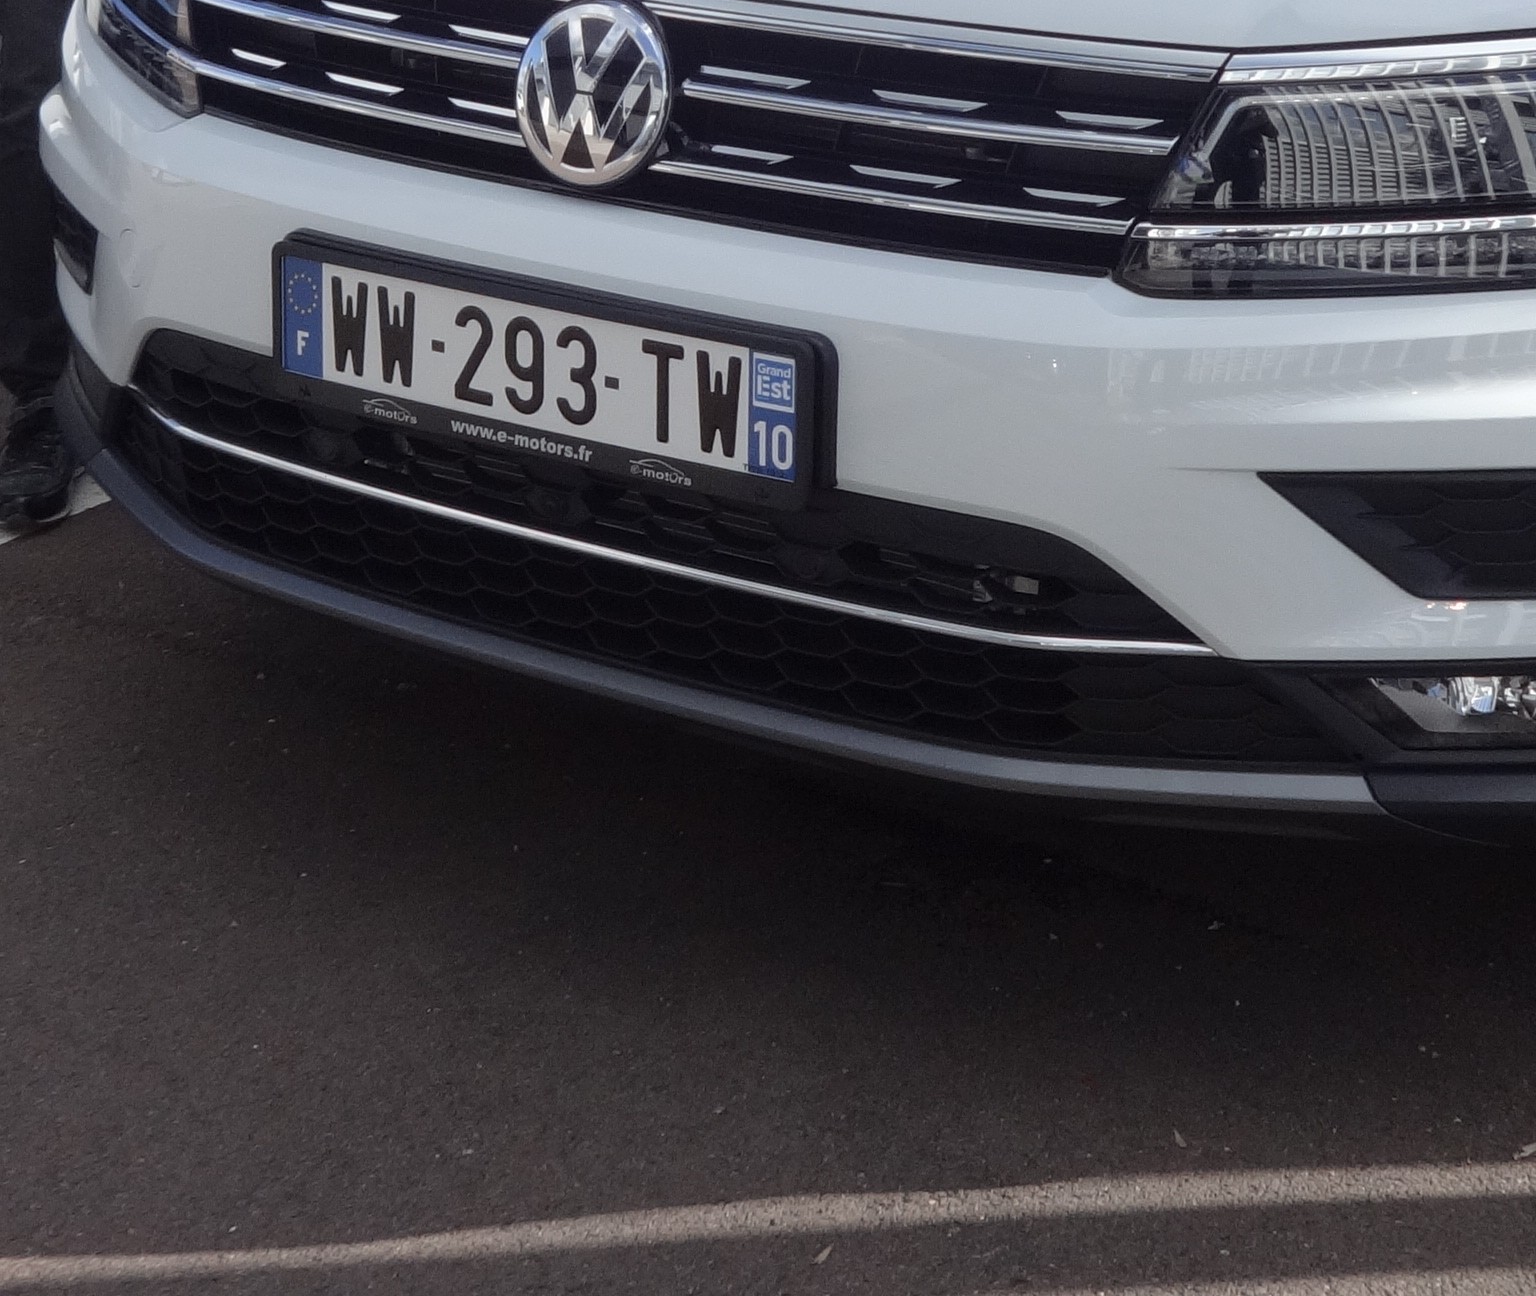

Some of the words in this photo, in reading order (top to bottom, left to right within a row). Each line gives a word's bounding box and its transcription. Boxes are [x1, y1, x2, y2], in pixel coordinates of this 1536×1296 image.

[296, 330, 309, 356] F
[331, 275, 742, 458] WW-293-TW
[757, 363, 791, 379] Grand
[756, 374, 791, 401] Est
[451, 419, 593, 462] www.e-motors.fr
[753, 421, 793, 471] 10
